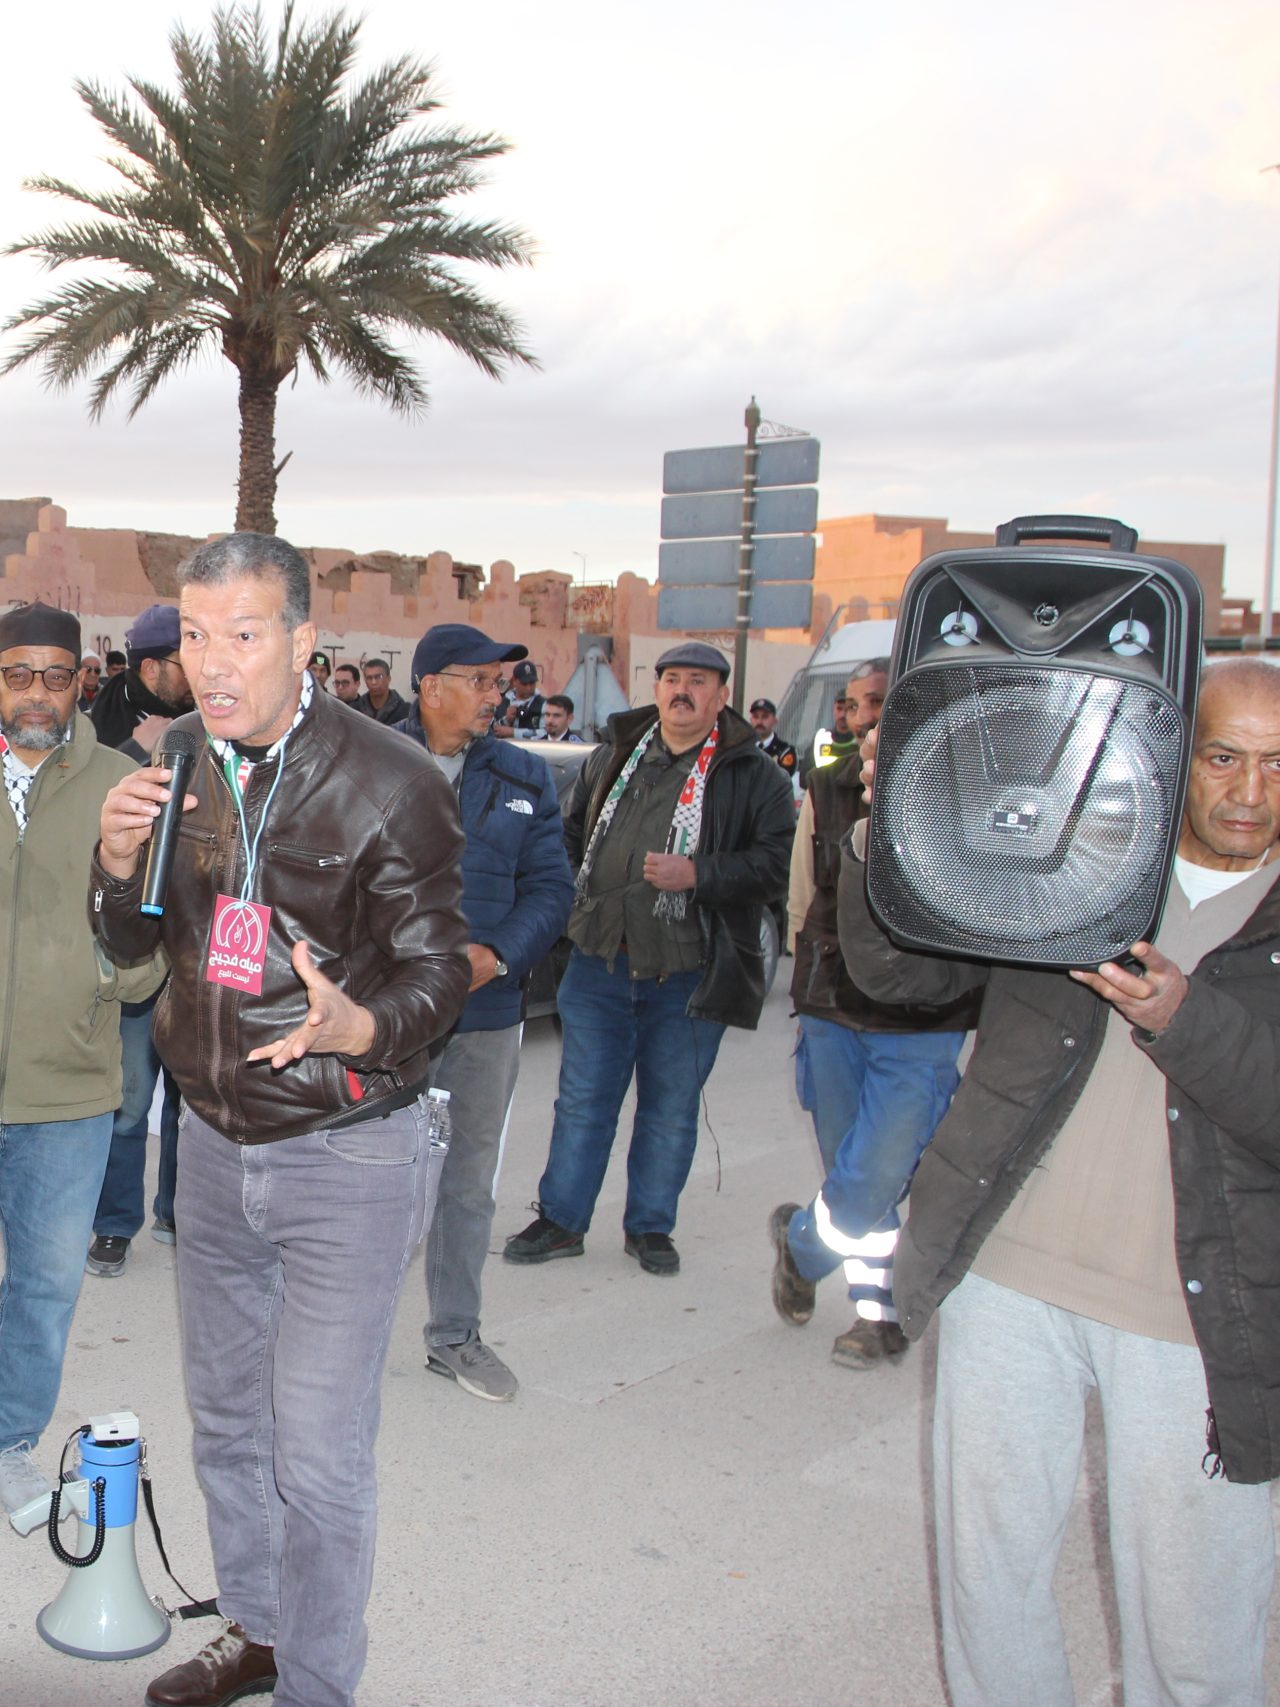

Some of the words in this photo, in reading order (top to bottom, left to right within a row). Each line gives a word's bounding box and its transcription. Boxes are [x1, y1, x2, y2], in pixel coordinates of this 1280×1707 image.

[96, 634, 112, 656] 10
[209, 950, 238, 967] فجيج
[239, 957, 262, 974] مياه
[218, 969, 232, 978] للبيع
[232, 973, 250, 984] ليست
